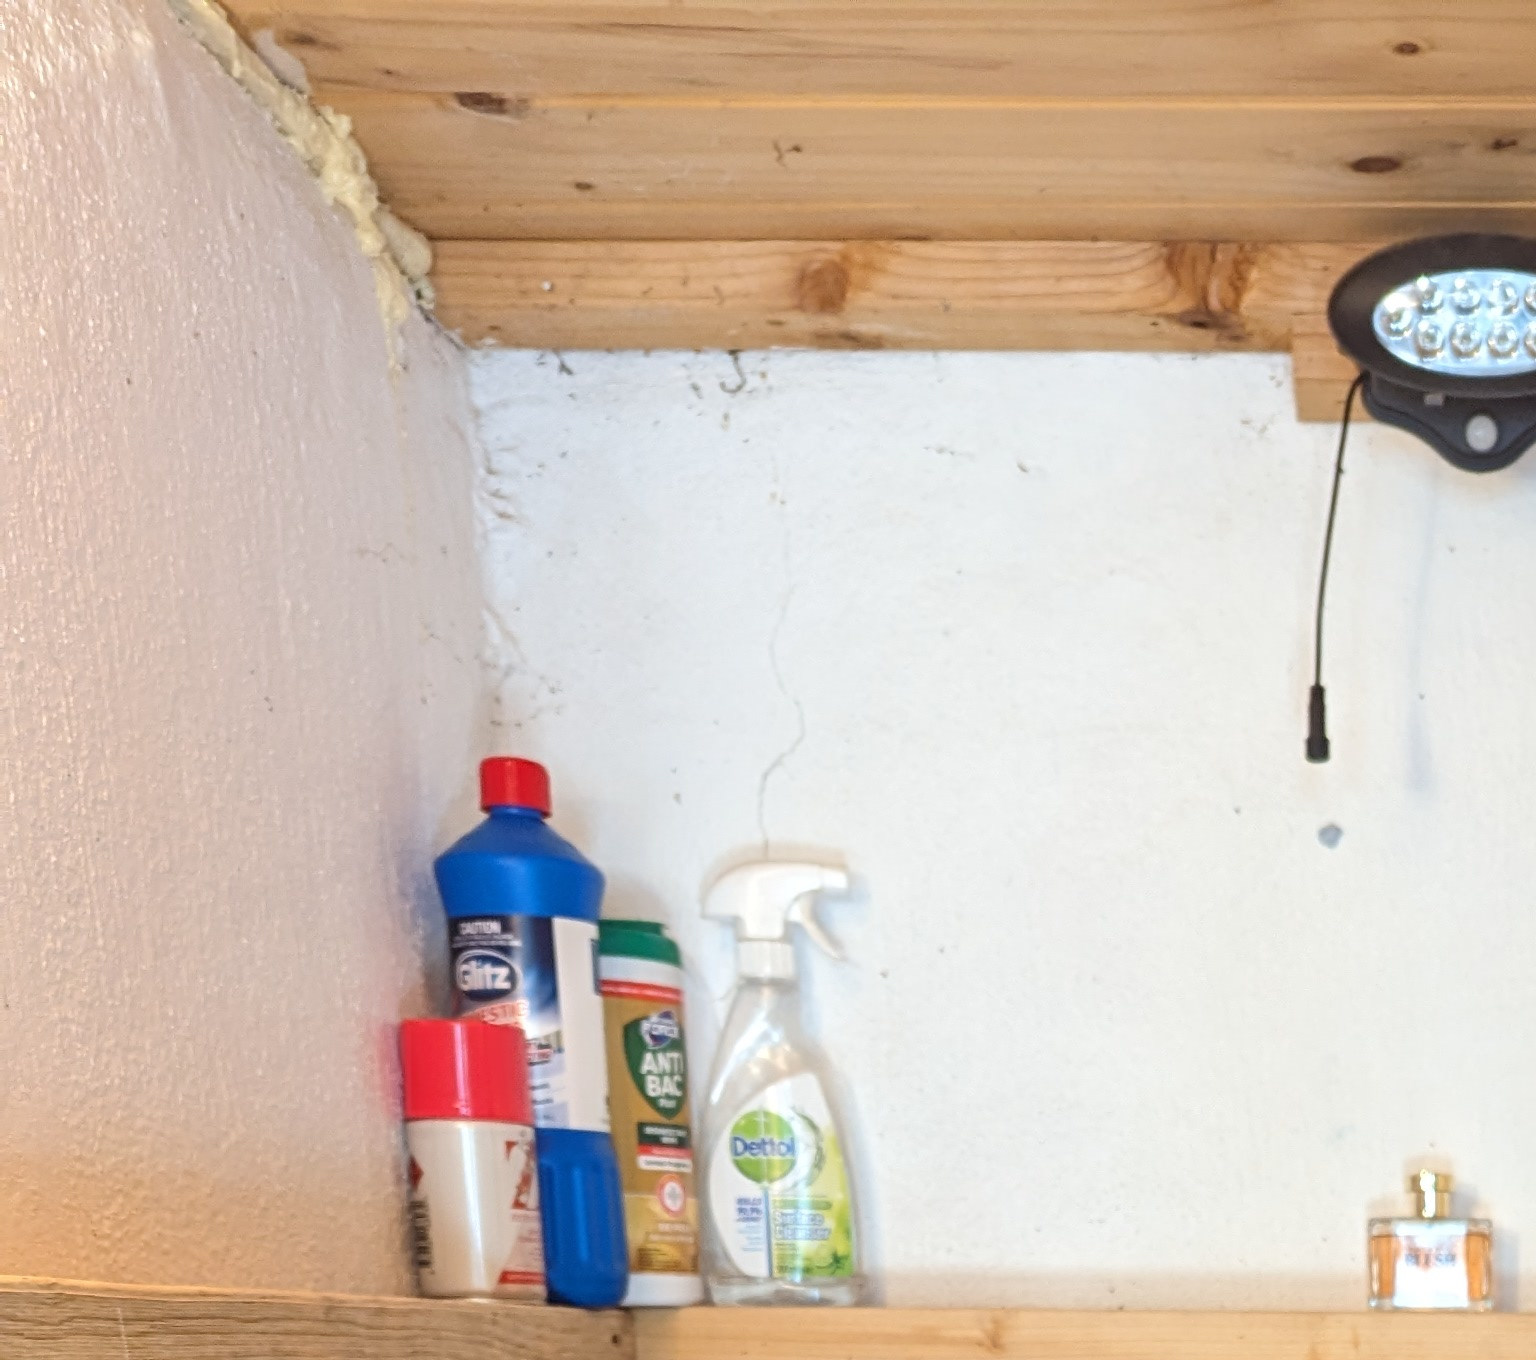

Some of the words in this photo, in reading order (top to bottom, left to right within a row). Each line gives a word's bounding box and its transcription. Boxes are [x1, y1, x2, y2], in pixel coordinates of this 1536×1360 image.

[459, 959, 511, 991] Glitz
[640, 1052, 684, 1075] ANTI
[645, 1074, 683, 1097] BAC
[730, 1136, 796, 1157] Dettol
